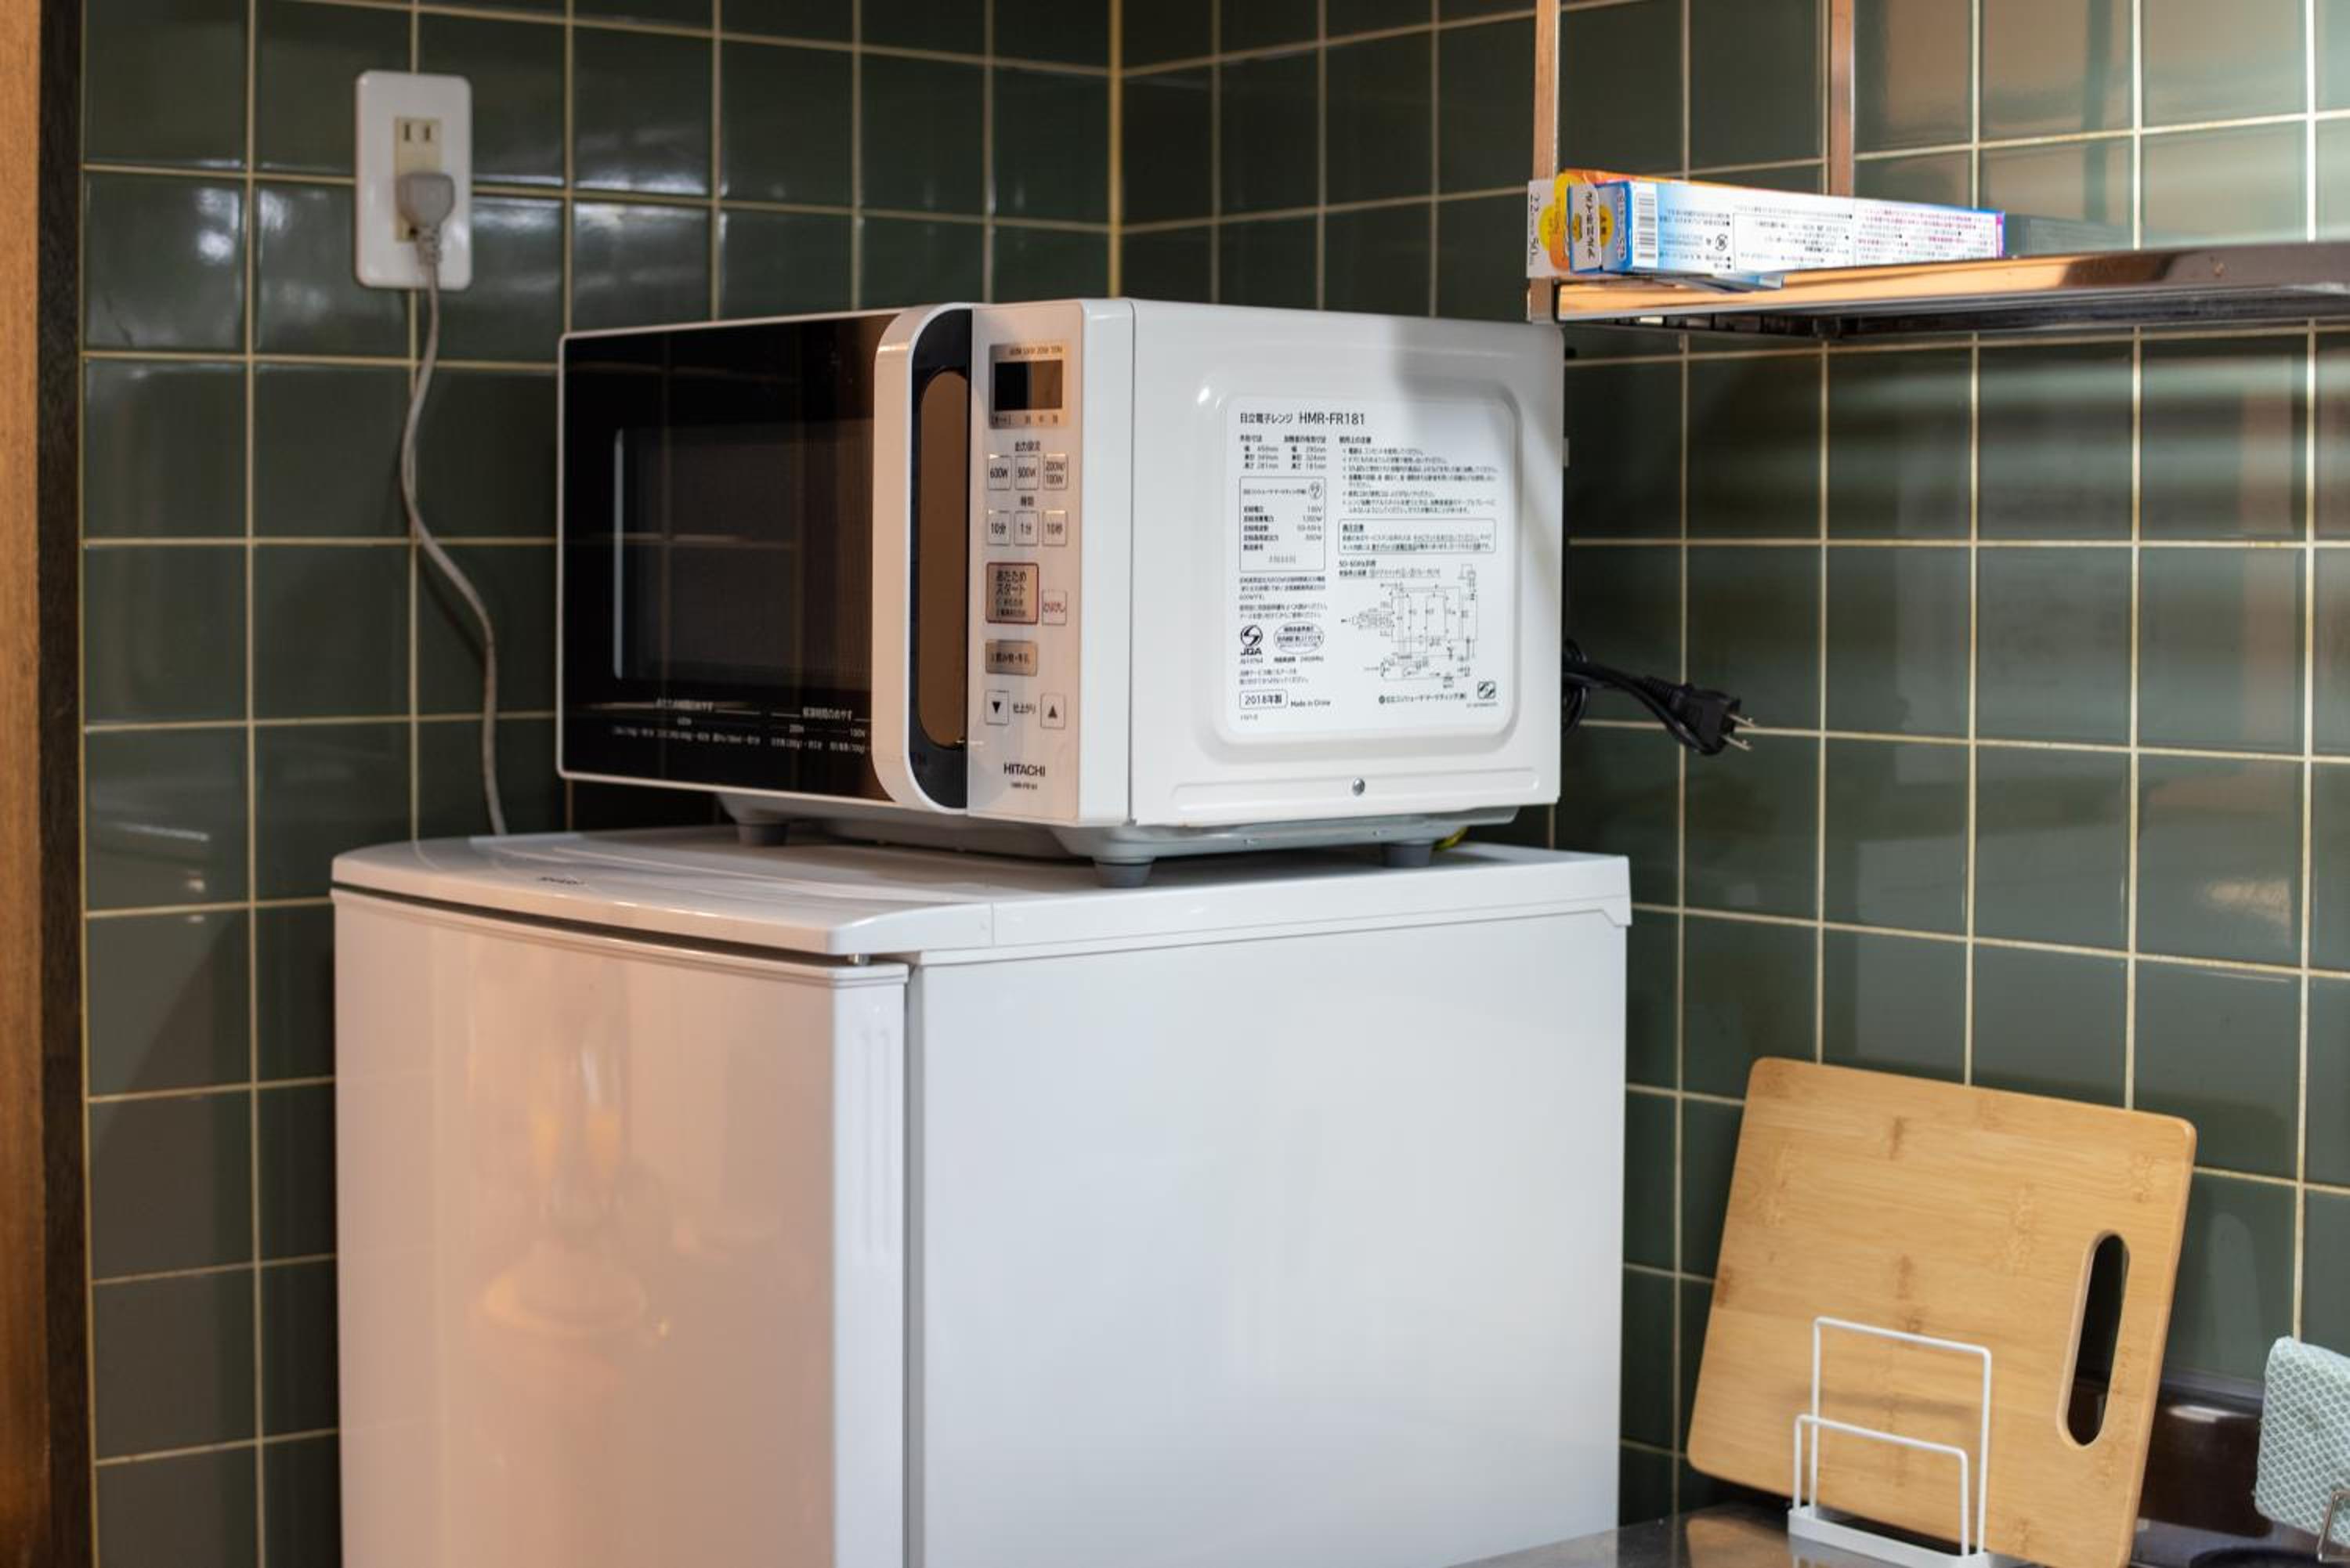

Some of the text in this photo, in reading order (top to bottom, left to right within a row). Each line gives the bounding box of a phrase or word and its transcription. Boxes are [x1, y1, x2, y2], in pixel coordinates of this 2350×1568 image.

[1240, 411, 1365, 425] 日立電子レンジ HMR-FR181
[989, 466, 1009, 479] 600W
[1018, 466, 1036, 479] 500W
[1240, 647, 1262, 656] JQA
[1003, 762, 1046, 778] HITACHI
